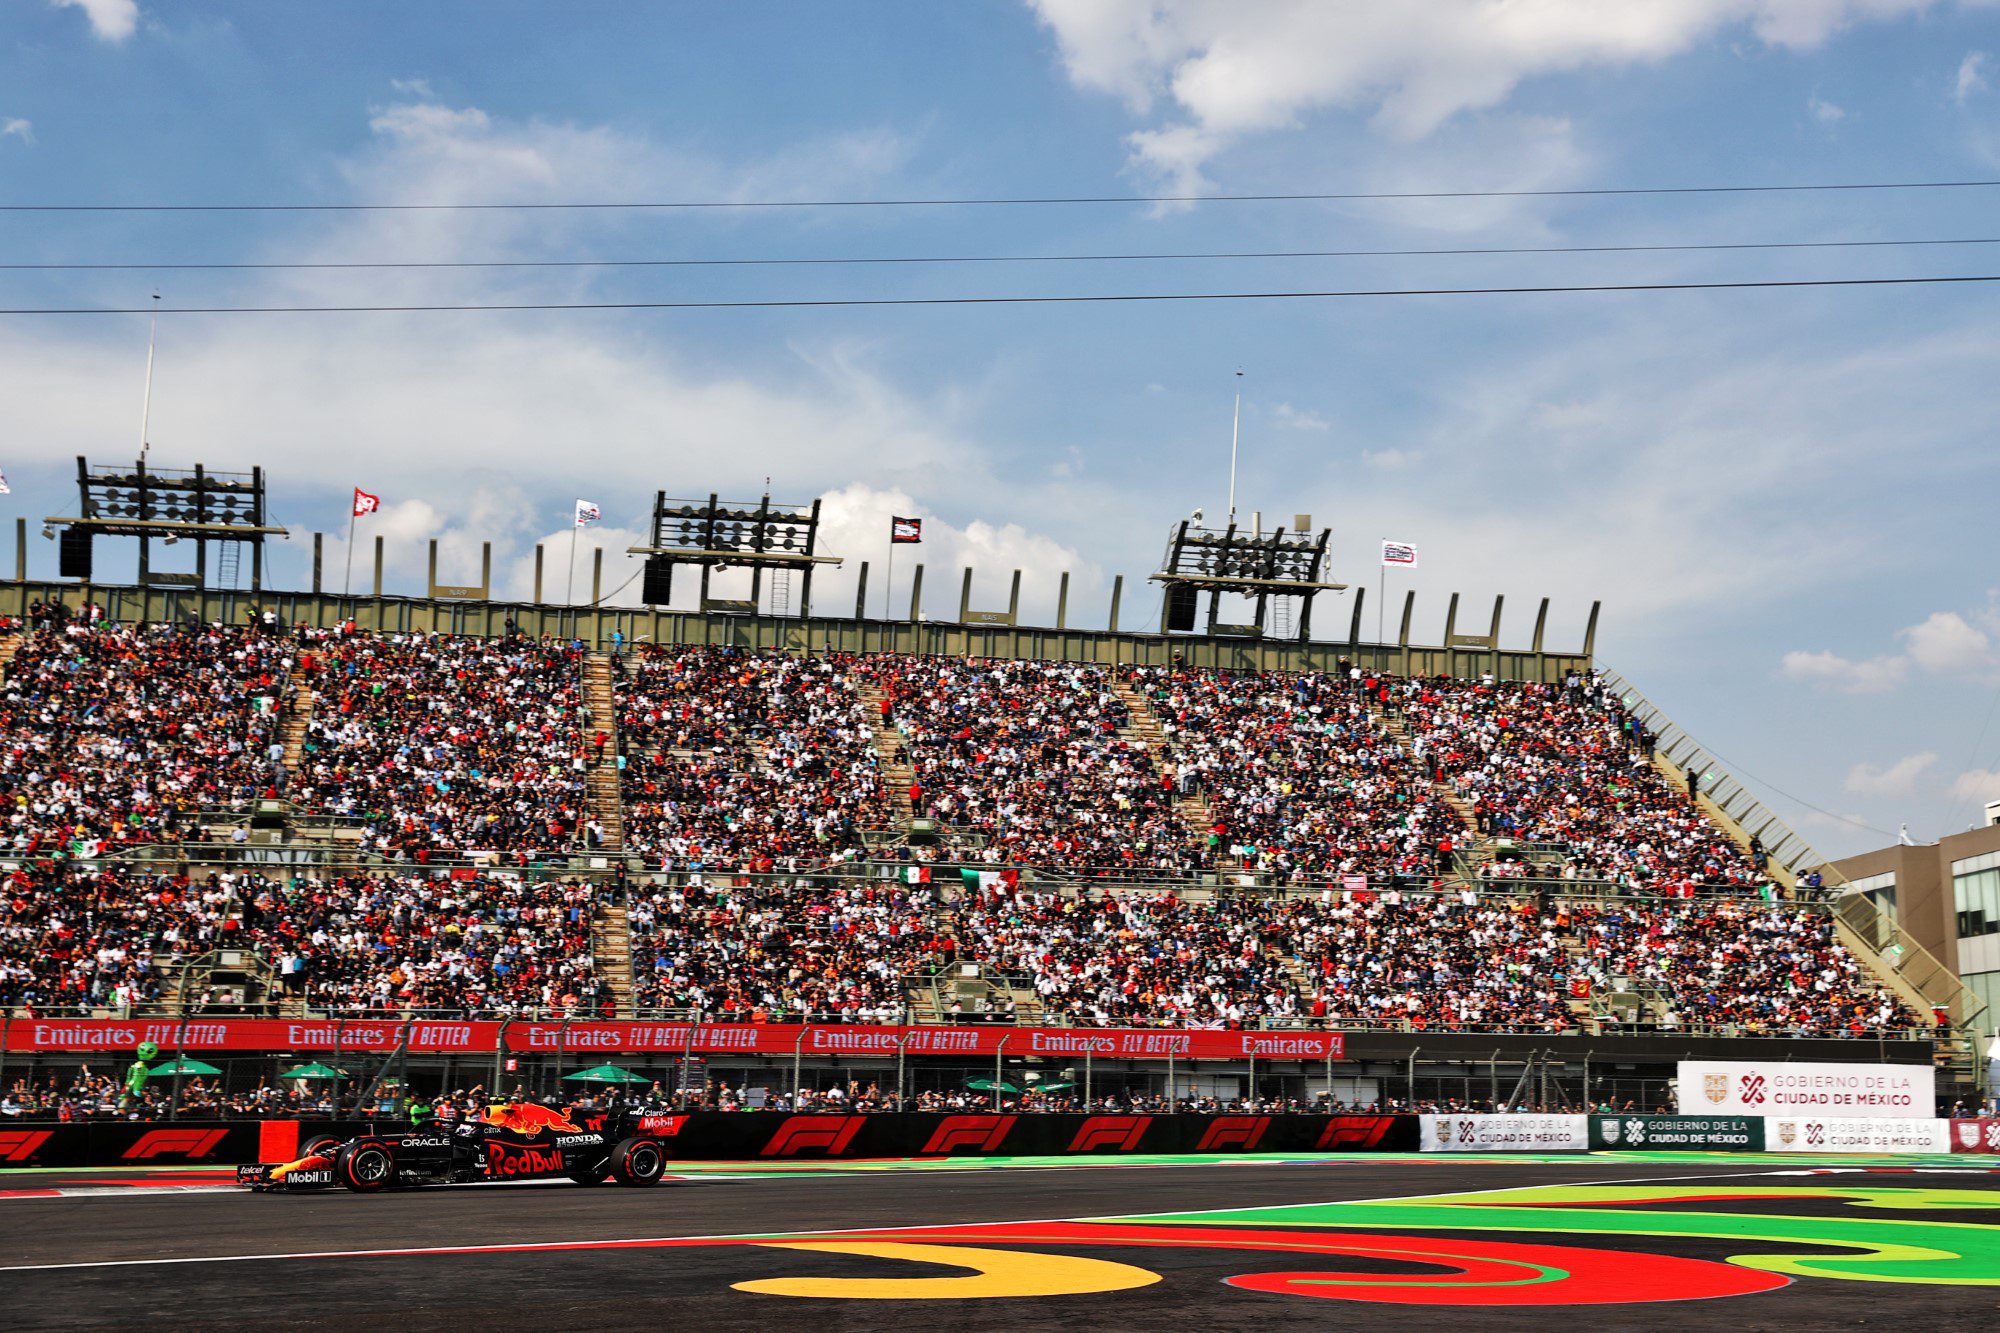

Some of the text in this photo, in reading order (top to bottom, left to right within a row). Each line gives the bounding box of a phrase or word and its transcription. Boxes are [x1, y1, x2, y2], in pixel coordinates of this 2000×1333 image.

[35, 1025, 136, 1045] Emirates
[145, 1025, 171, 1044] FLY
[289, 1025, 471, 1046] Emiates FY BETTER
[628, 1027, 651, 1046] FLY
[710, 1028, 758, 1047] BETTER
[813, 1029, 979, 1050] Emirates FLY BETTER
[1031, 1032, 1115, 1052] Emirates
[1122, 1034, 1144, 1052] FLY
[1241, 1036, 1323, 1054] Emirates
[1774, 1076, 1912, 1089] GOBIERNO DE LA
[1774, 1092, 1912, 1106] CIUDAD DE MÉXICO
[644, 1117, 673, 1128] Mobil
[1480, 1120, 1571, 1130] GOBIERNO DE LA
[1648, 1121, 1748, 1131] GOBIERNO DE LA
[1829, 1123, 1931, 1133] GOBIERNO DE LA
[401, 1138, 451, 1147] ORACLE
[556, 1134, 604, 1144] HONDA
[1480, 1131, 1572, 1143] CIUDAD DE MÉXICO
[1648, 1132, 1749, 1144] CIUDAD DE MÉXICO
[1830, 1135, 1932, 1146] CIUDAD DE MÉXICO
[240, 1164, 265, 1175] telcel
[287, 1172, 319, 1184] Mobil
